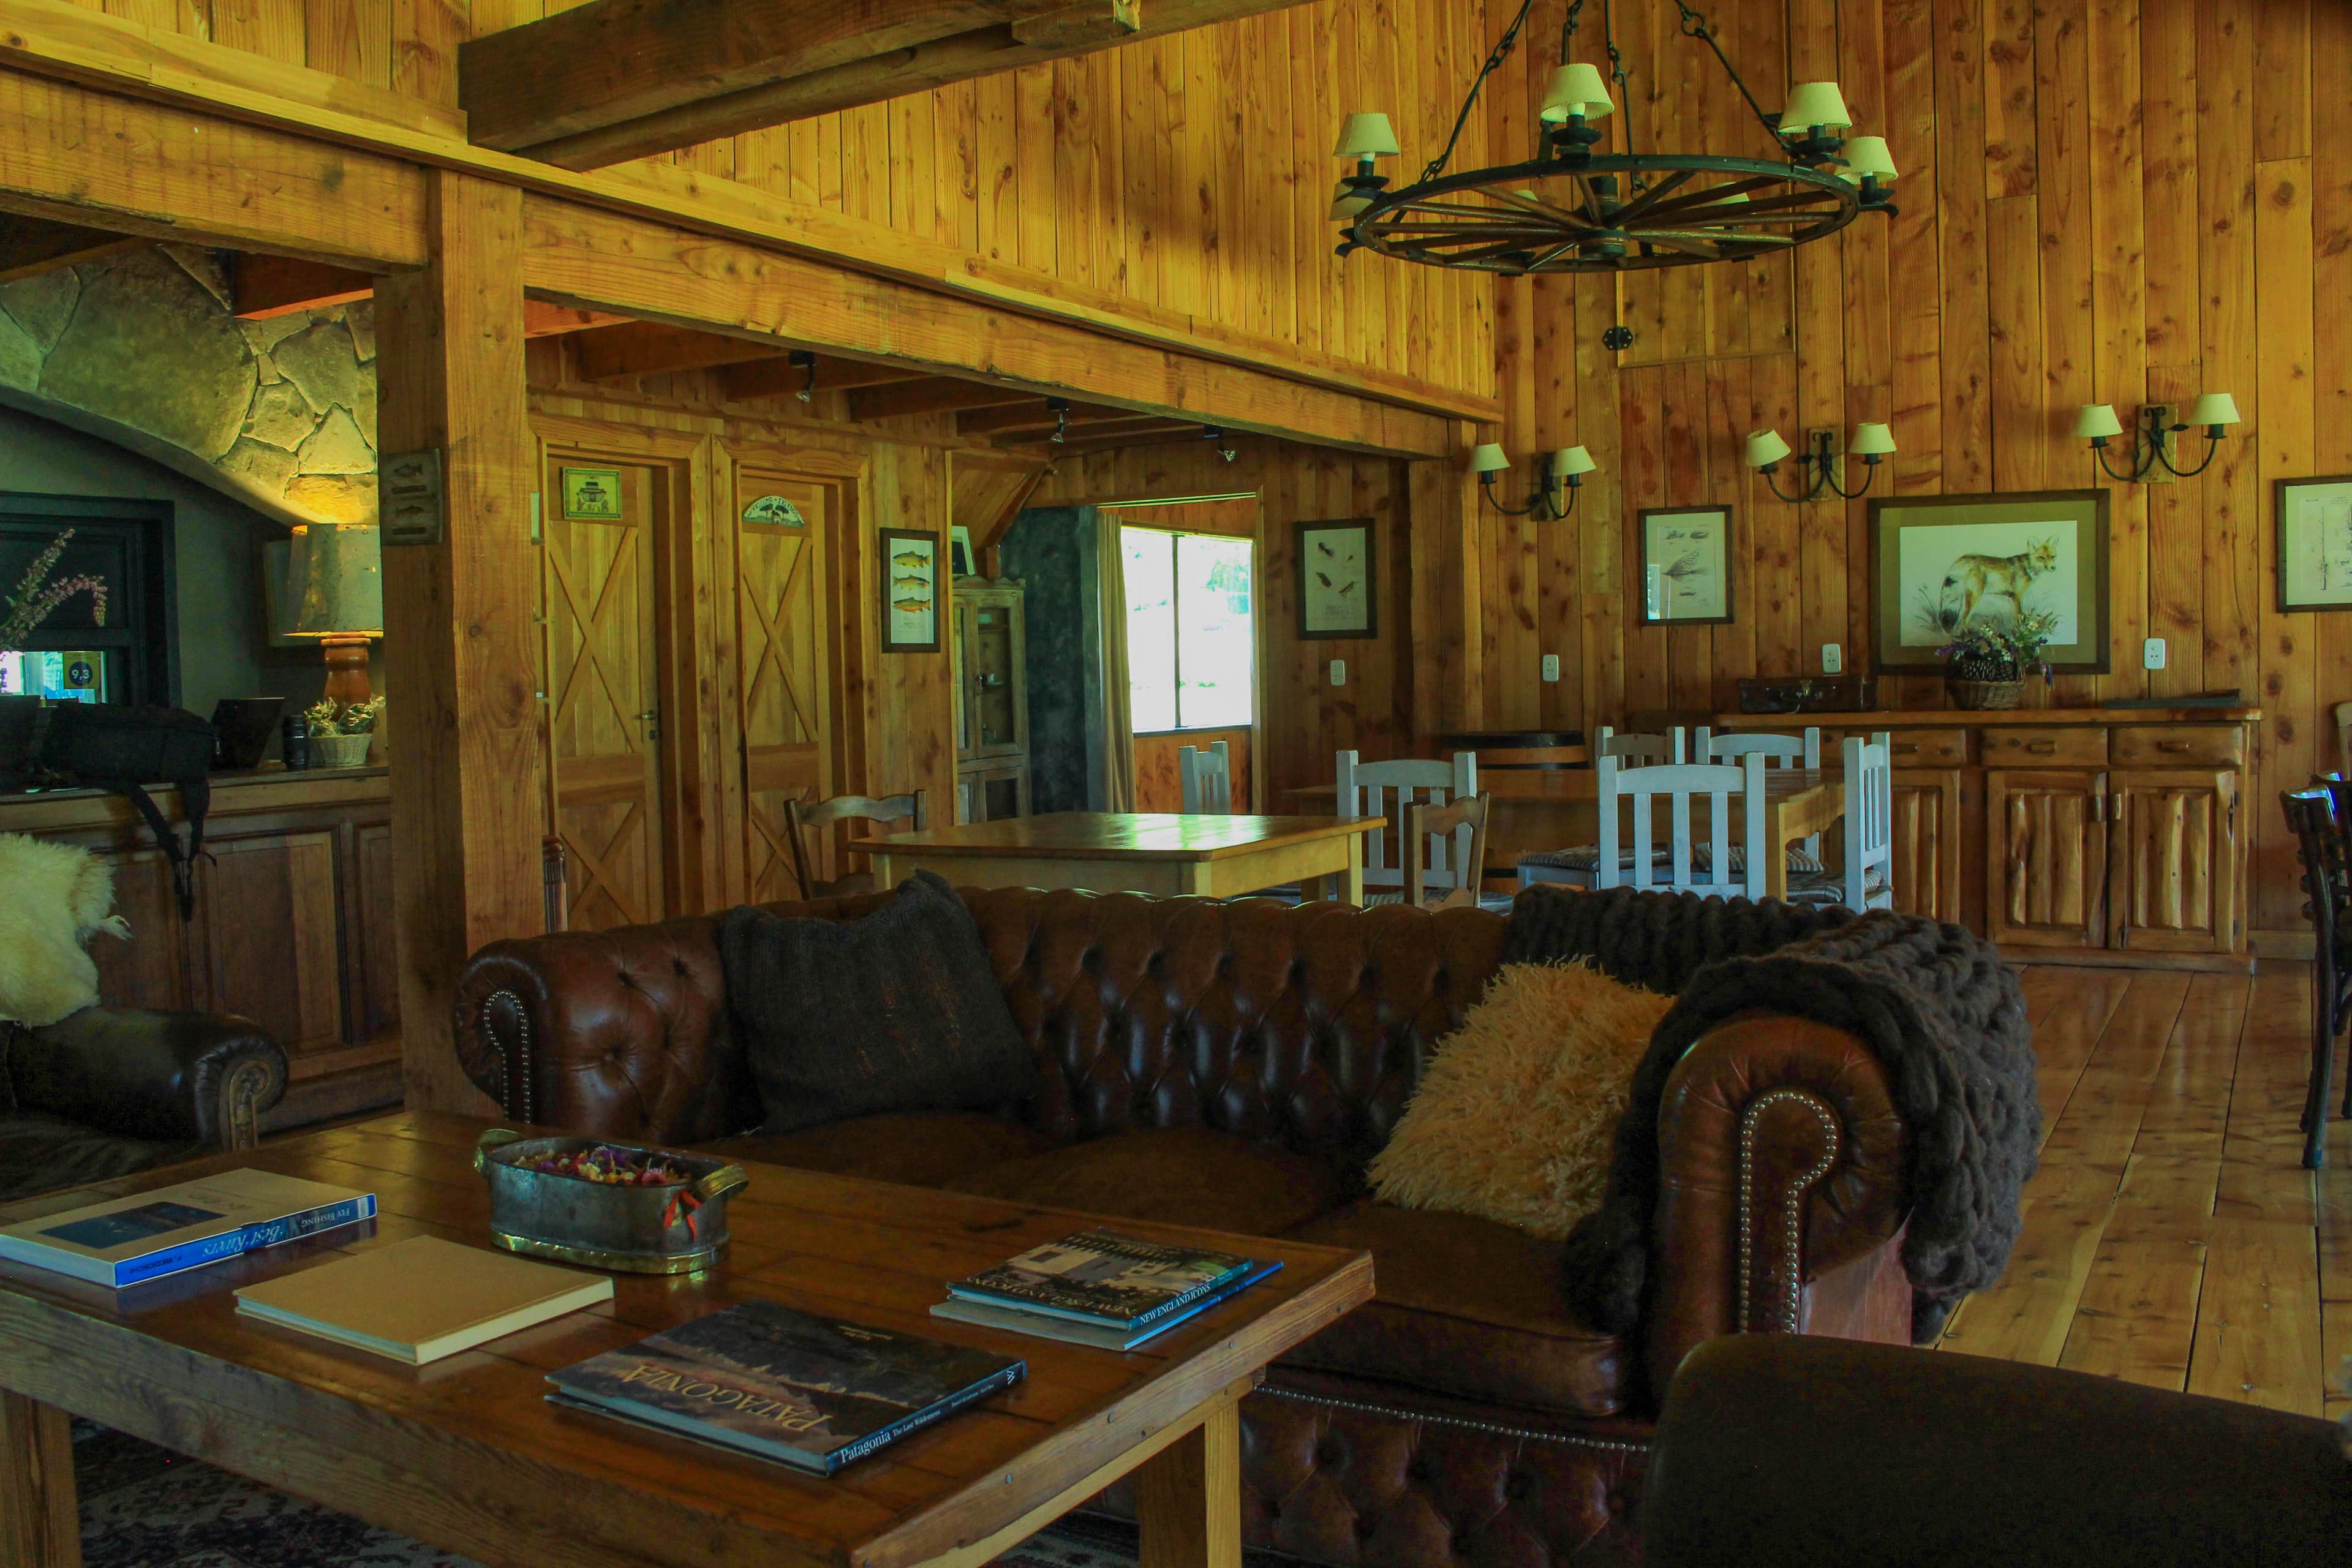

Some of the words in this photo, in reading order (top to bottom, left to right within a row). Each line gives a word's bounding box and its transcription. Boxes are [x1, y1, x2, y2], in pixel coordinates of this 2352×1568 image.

[72, 669, 89, 680] 9,3
[301, 1213, 336, 1227] FISHING
[339, 1207, 350, 1217] FLY
[203, 1234, 248, 1257] Rivers
[251, 1225, 283, 1245] Best
[1140, 1309, 1157, 1325] NEW
[1157, 1294, 1190, 1316] ENGLAND
[1190, 1283, 1211, 1300] ICONS
[622, 1365, 833, 1431] PATAGONIA
[840, 1430, 891, 1463] Patagonia
[892, 1428, 903, 1436] The
[903, 1422, 914, 1431] Last
[914, 1410, 941, 1425] Wilderness
